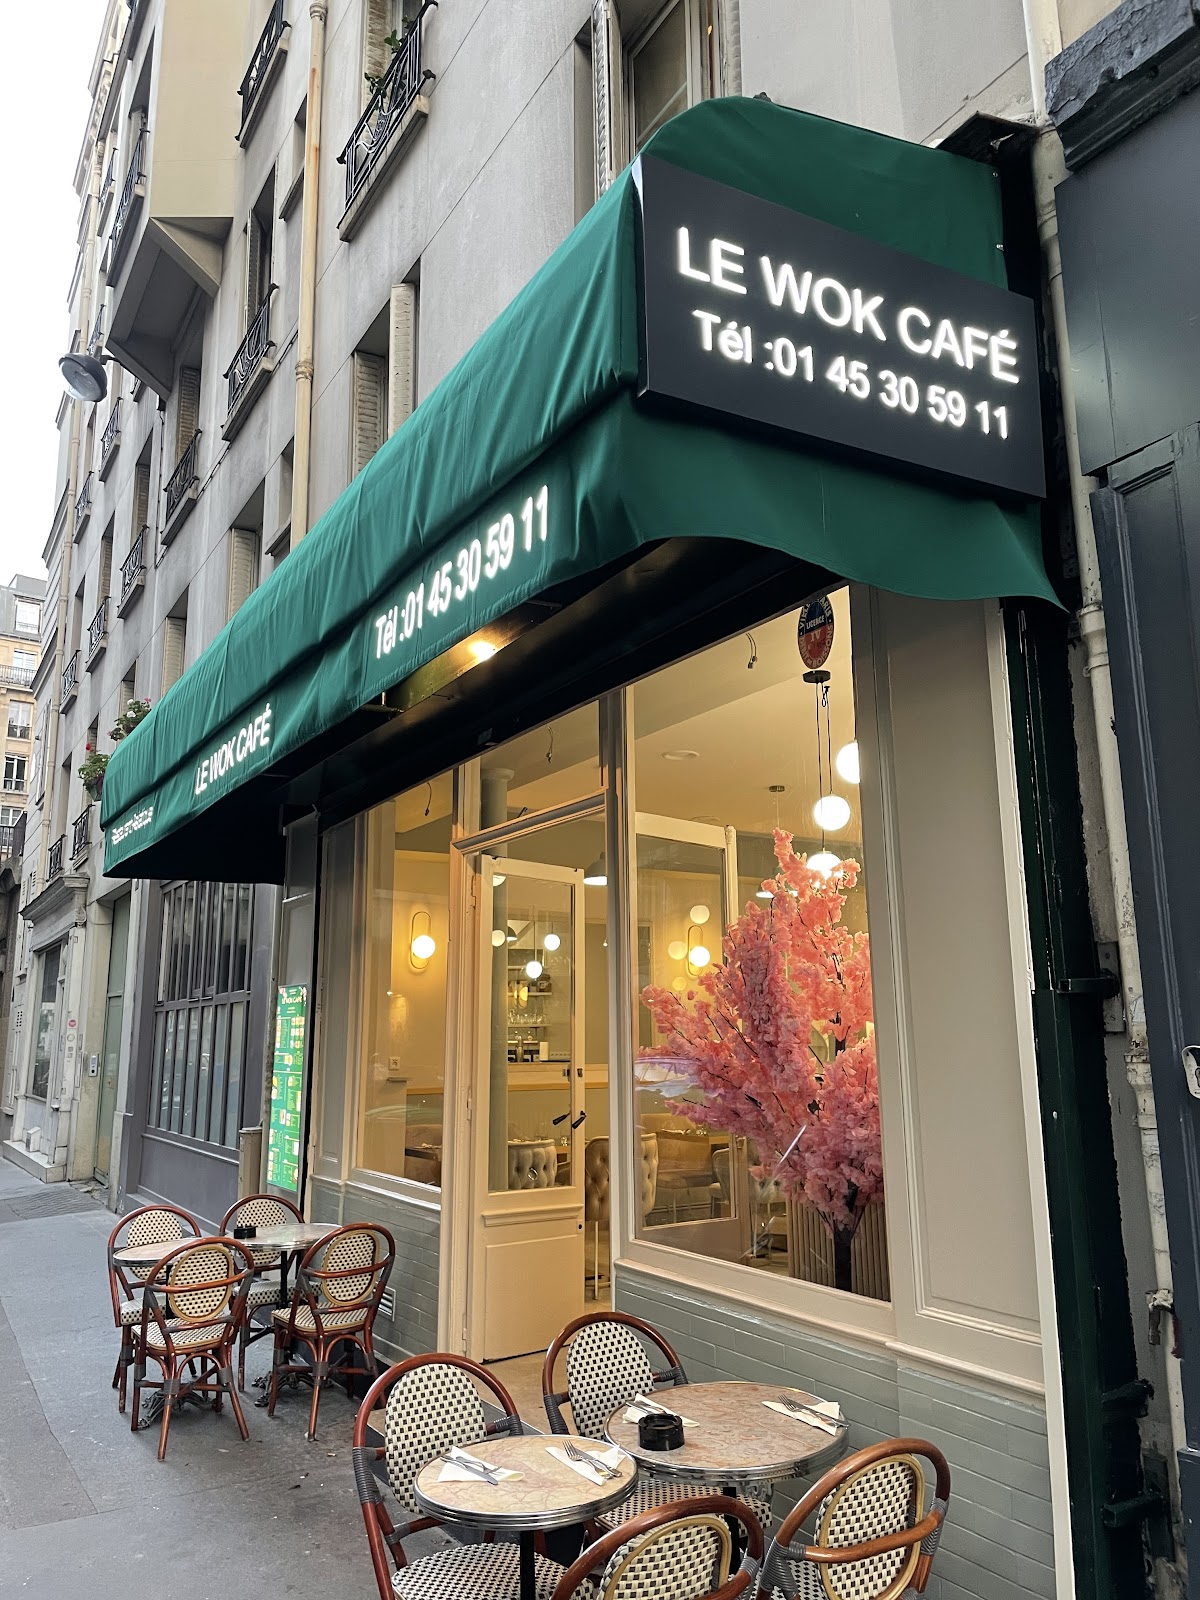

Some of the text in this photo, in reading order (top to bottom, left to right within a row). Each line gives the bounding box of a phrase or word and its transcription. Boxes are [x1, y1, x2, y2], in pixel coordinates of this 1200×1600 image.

[677, 225, 1020, 385] LE WOK CAFÉ
[692, 308, 753, 364] Tél
[826, 354, 871, 399] 45
[878, 368, 920, 414] 30
[927, 383, 968, 428] 59
[975, 400, 1009, 440] 11
[375, 604, 399, 660] Tél
[427, 560, 453, 618] 45
[455, 538, 482, 602] 30
[484, 512, 516, 580] 59
[521, 484, 549, 552] 11
[806, 615, 825, 630] LICENCE
[194, 702, 272, 796] LE WOK CAFÉ
